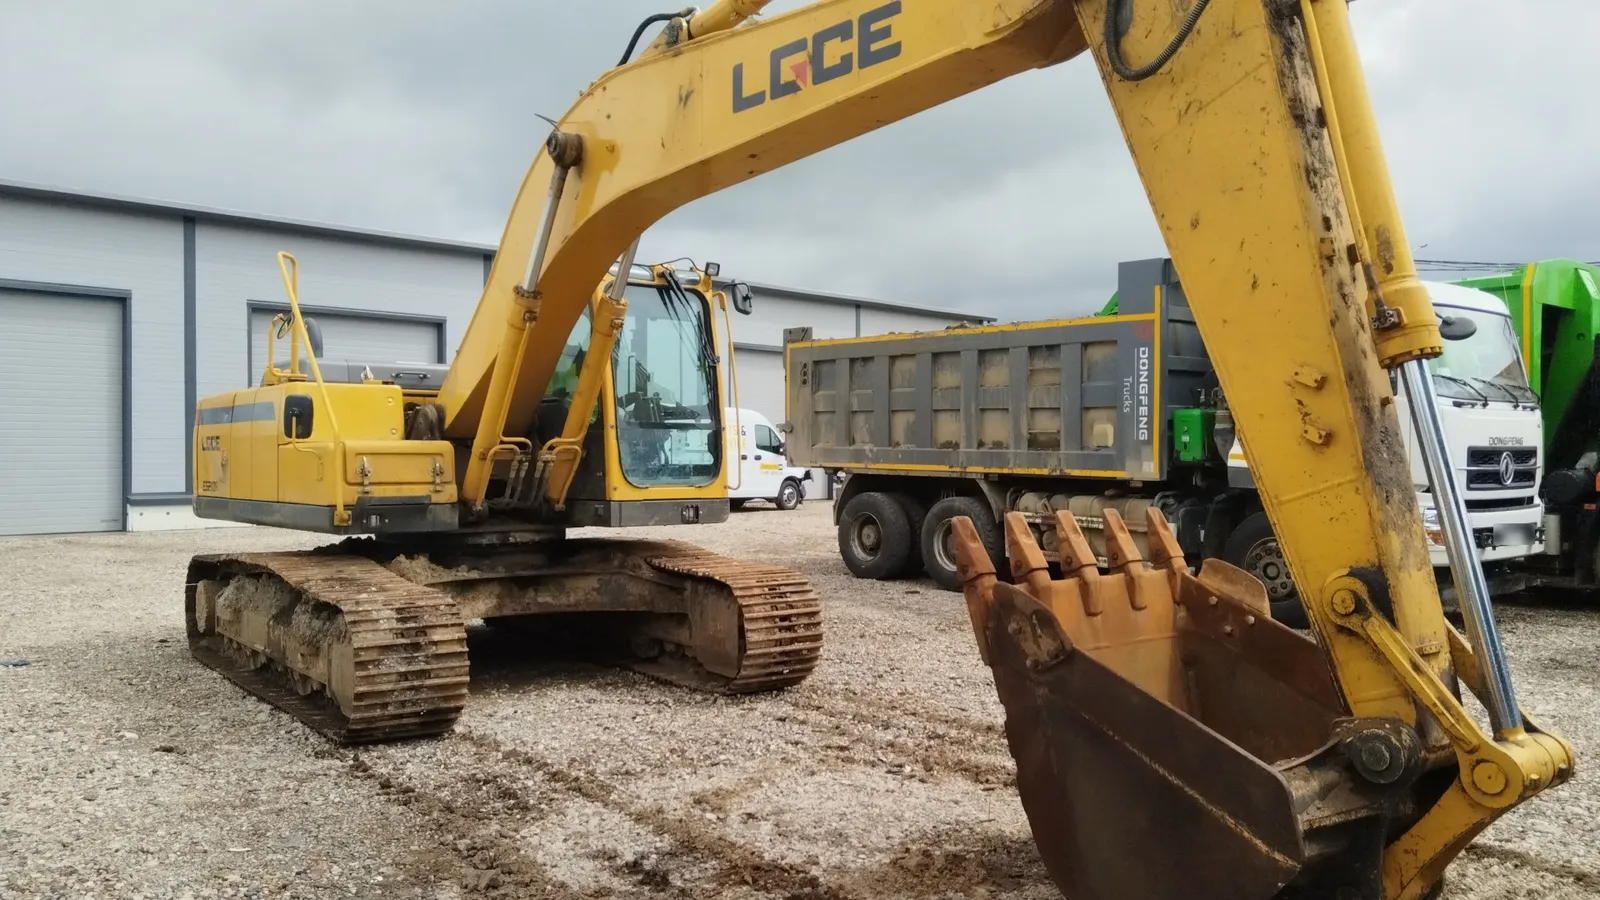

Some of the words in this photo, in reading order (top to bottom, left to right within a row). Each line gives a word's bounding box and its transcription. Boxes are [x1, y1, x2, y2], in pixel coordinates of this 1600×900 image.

[1123, 376, 1133, 413] Trucks
[1138, 347, 1149, 441] DONGFENG
[1488, 436, 1524, 446] DONGFENG
